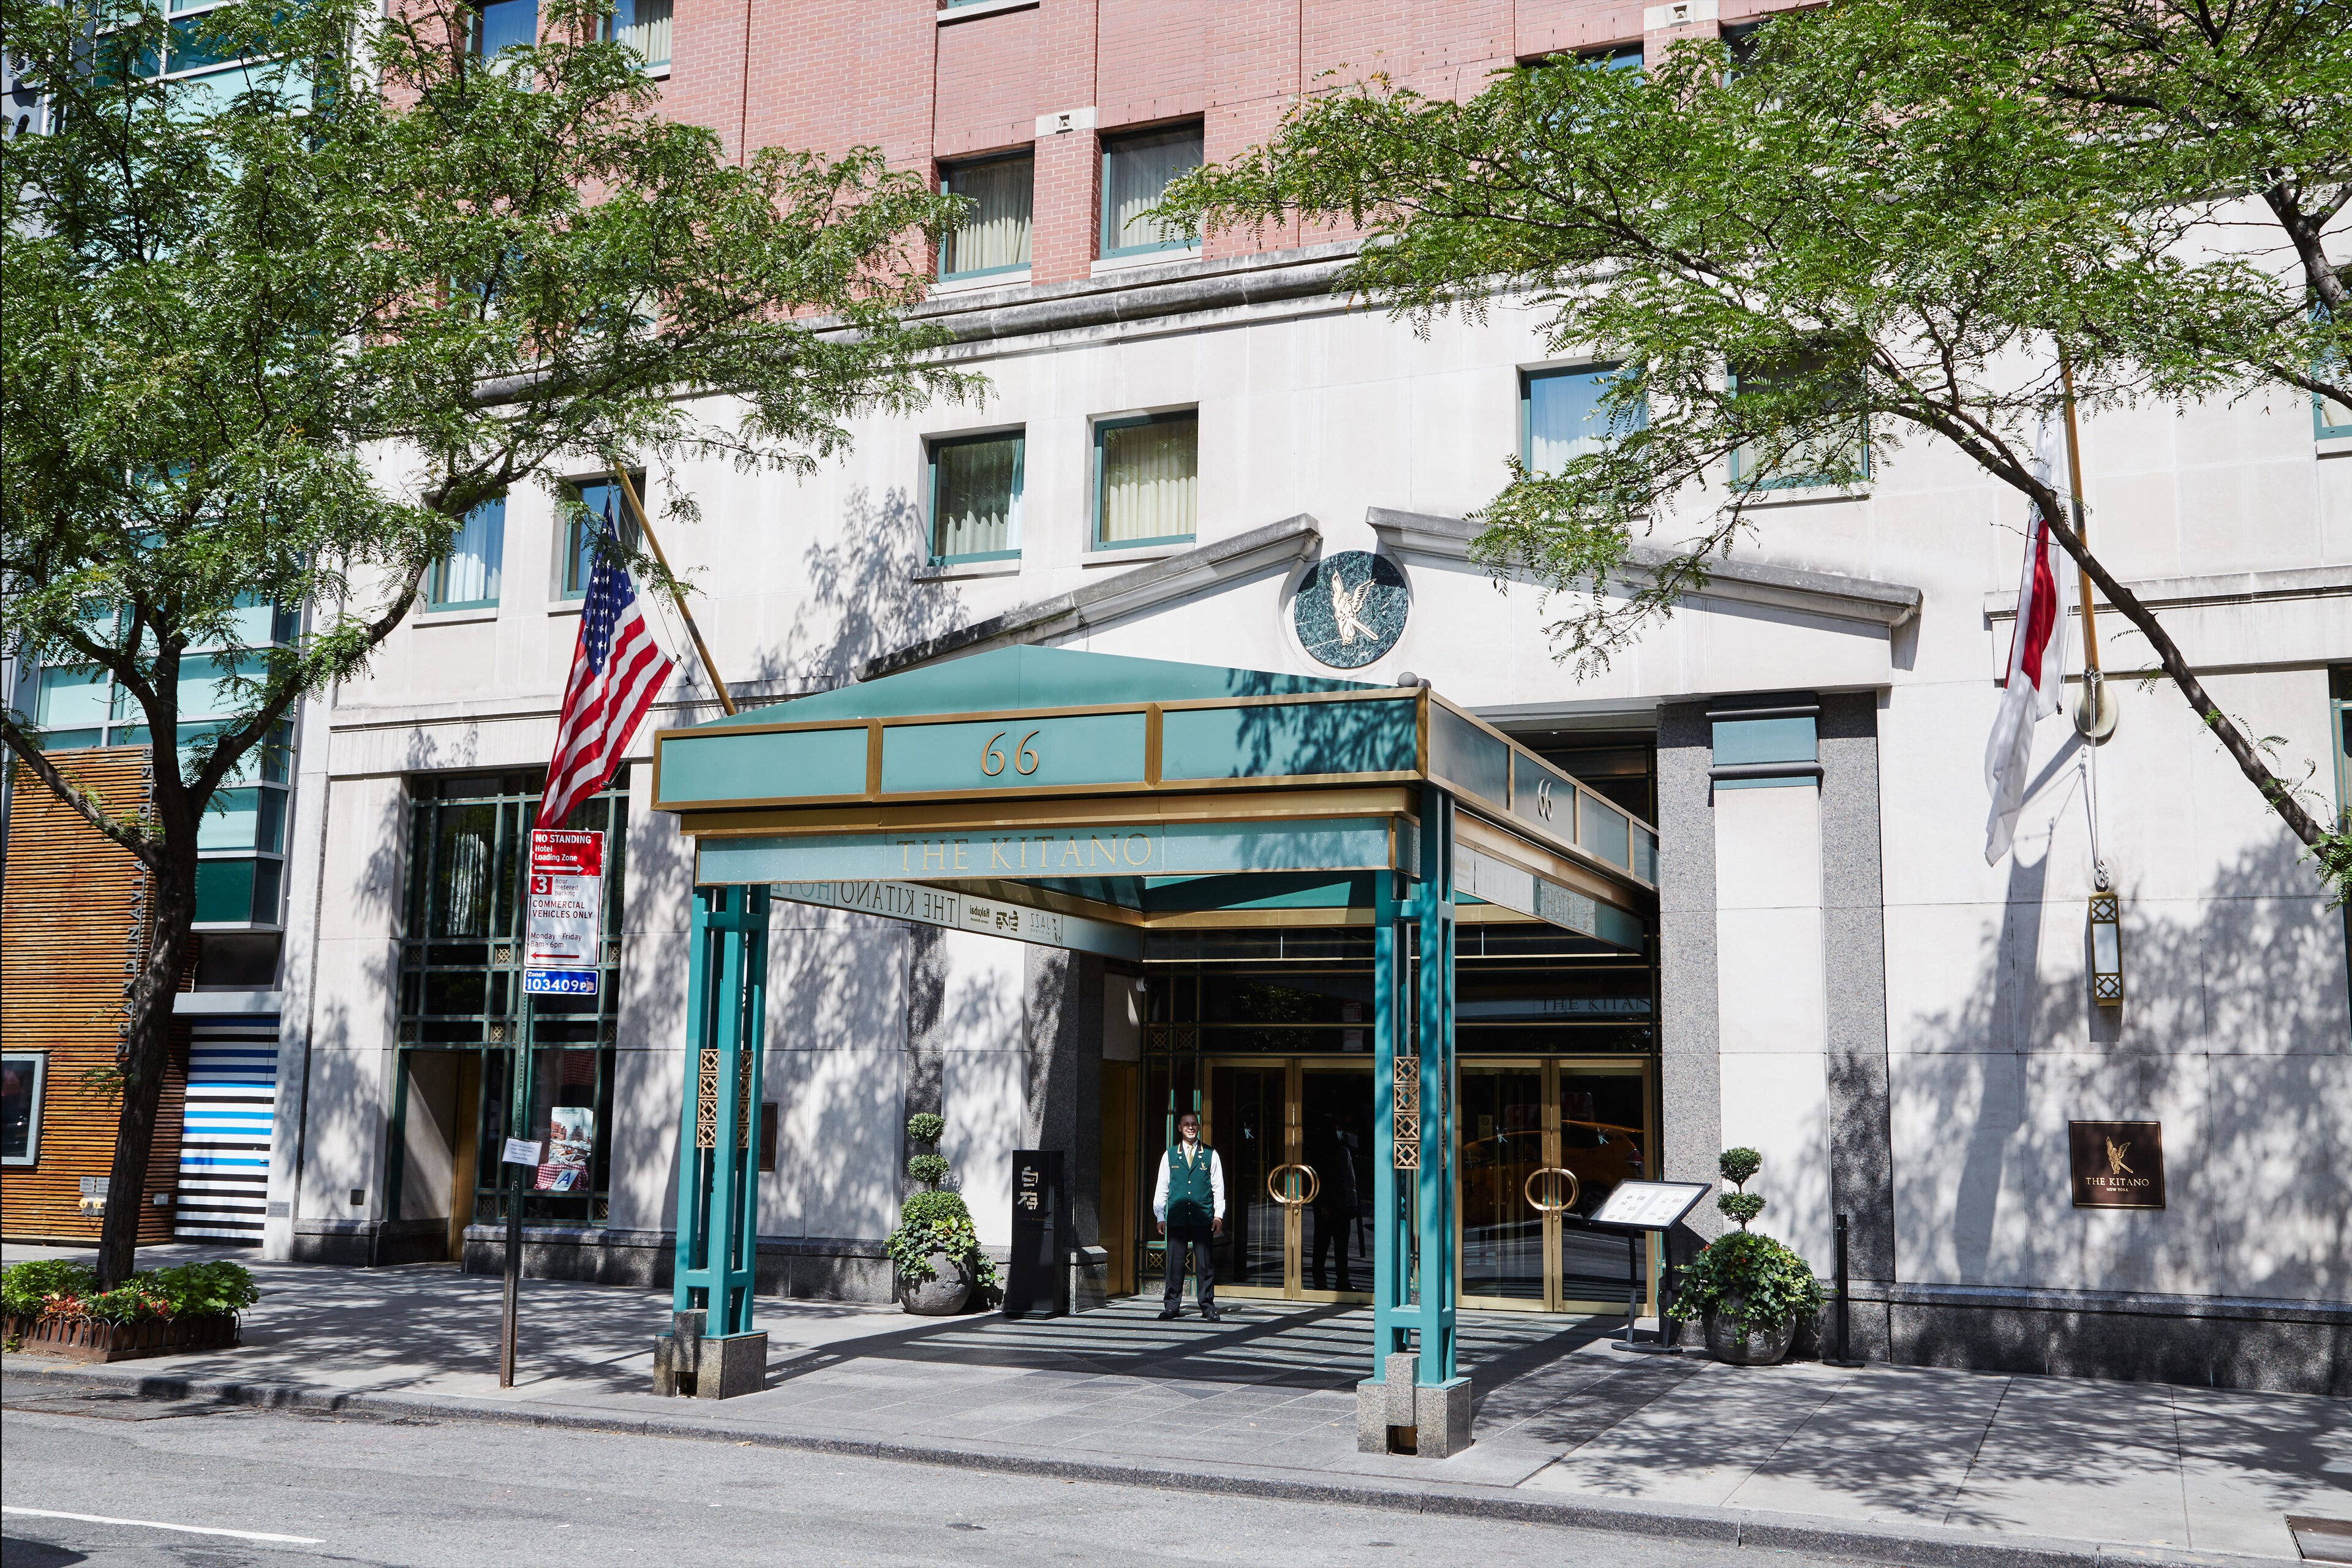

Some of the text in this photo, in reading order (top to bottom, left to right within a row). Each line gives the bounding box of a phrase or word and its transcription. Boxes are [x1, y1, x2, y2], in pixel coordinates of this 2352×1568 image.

[981, 729, 1040, 777] 66
[1538, 778, 1553, 821] 66
[535, 834, 592, 844] NO STANDING
[534, 853, 560, 862] Loading
[896, 832, 1152, 872] THE KITANO
[535, 876, 548, 894] 3
[532, 900, 585, 909] COMMERCIAL
[532, 910, 570, 918] VEHICLES
[562, 933, 582, 941] Friday
[527, 978, 579, 991] 103409
[557, 1172, 571, 1185] A
[2085, 1177, 2150, 1186] THE KITANO
